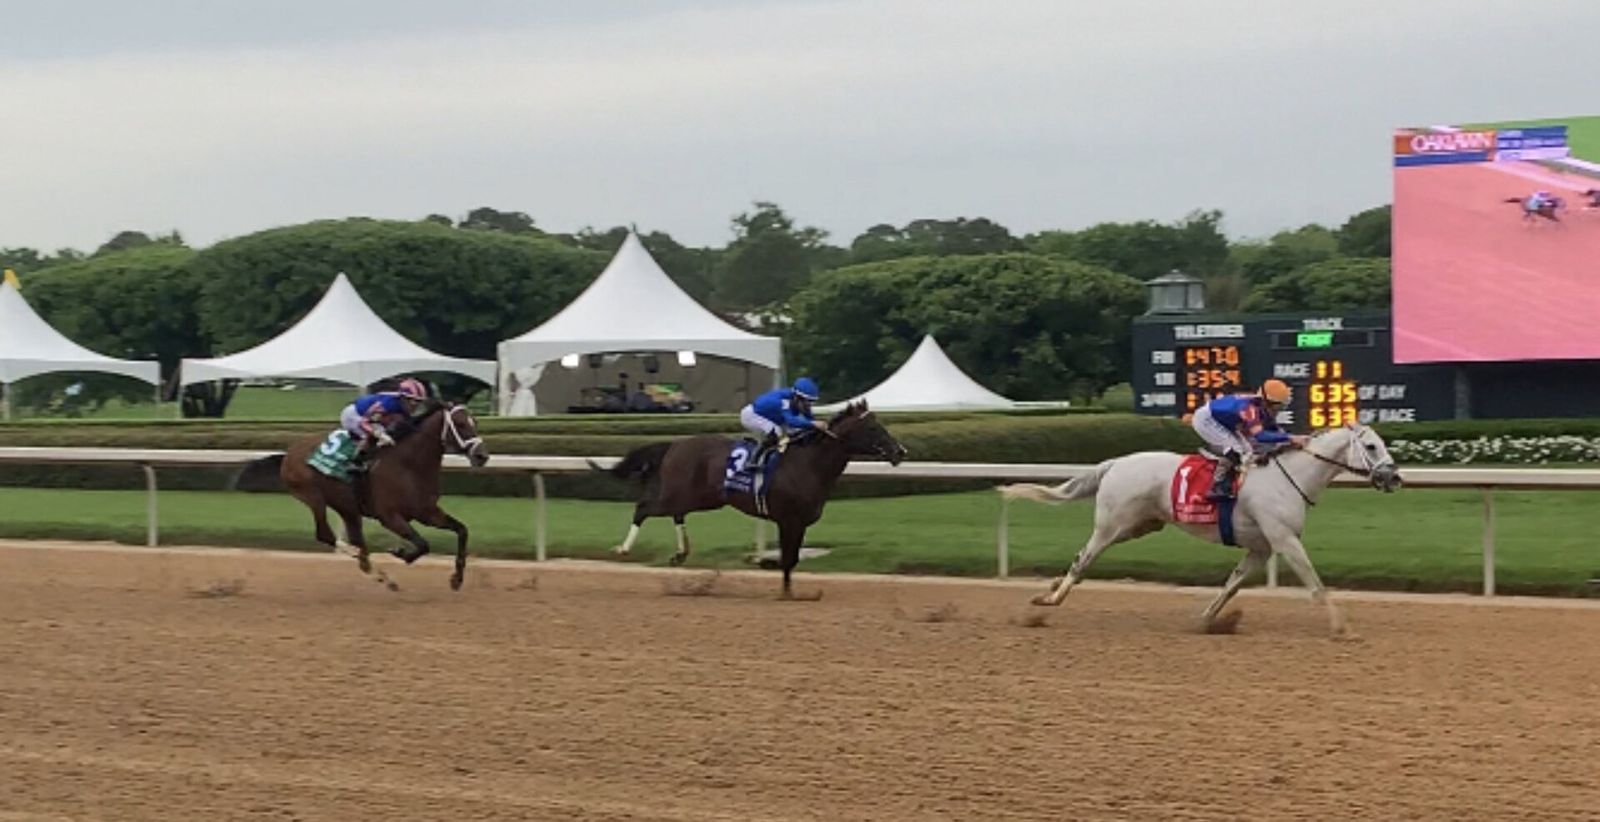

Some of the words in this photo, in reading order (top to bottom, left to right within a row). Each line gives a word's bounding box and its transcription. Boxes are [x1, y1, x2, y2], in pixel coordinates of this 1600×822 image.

[1273, 363, 1311, 378] RACE
[1316, 360, 1342, 379] 11
[1310, 384, 1357, 403] 635
[1359, 385, 1377, 400] OF
[1379, 385, 1407, 399] DAY
[1359, 408, 1377, 422] OF
[1379, 408, 1416, 422] RACE
[321, 430, 350, 455] 5
[726, 448, 749, 478] 3
[1178, 466, 1193, 503] 1
